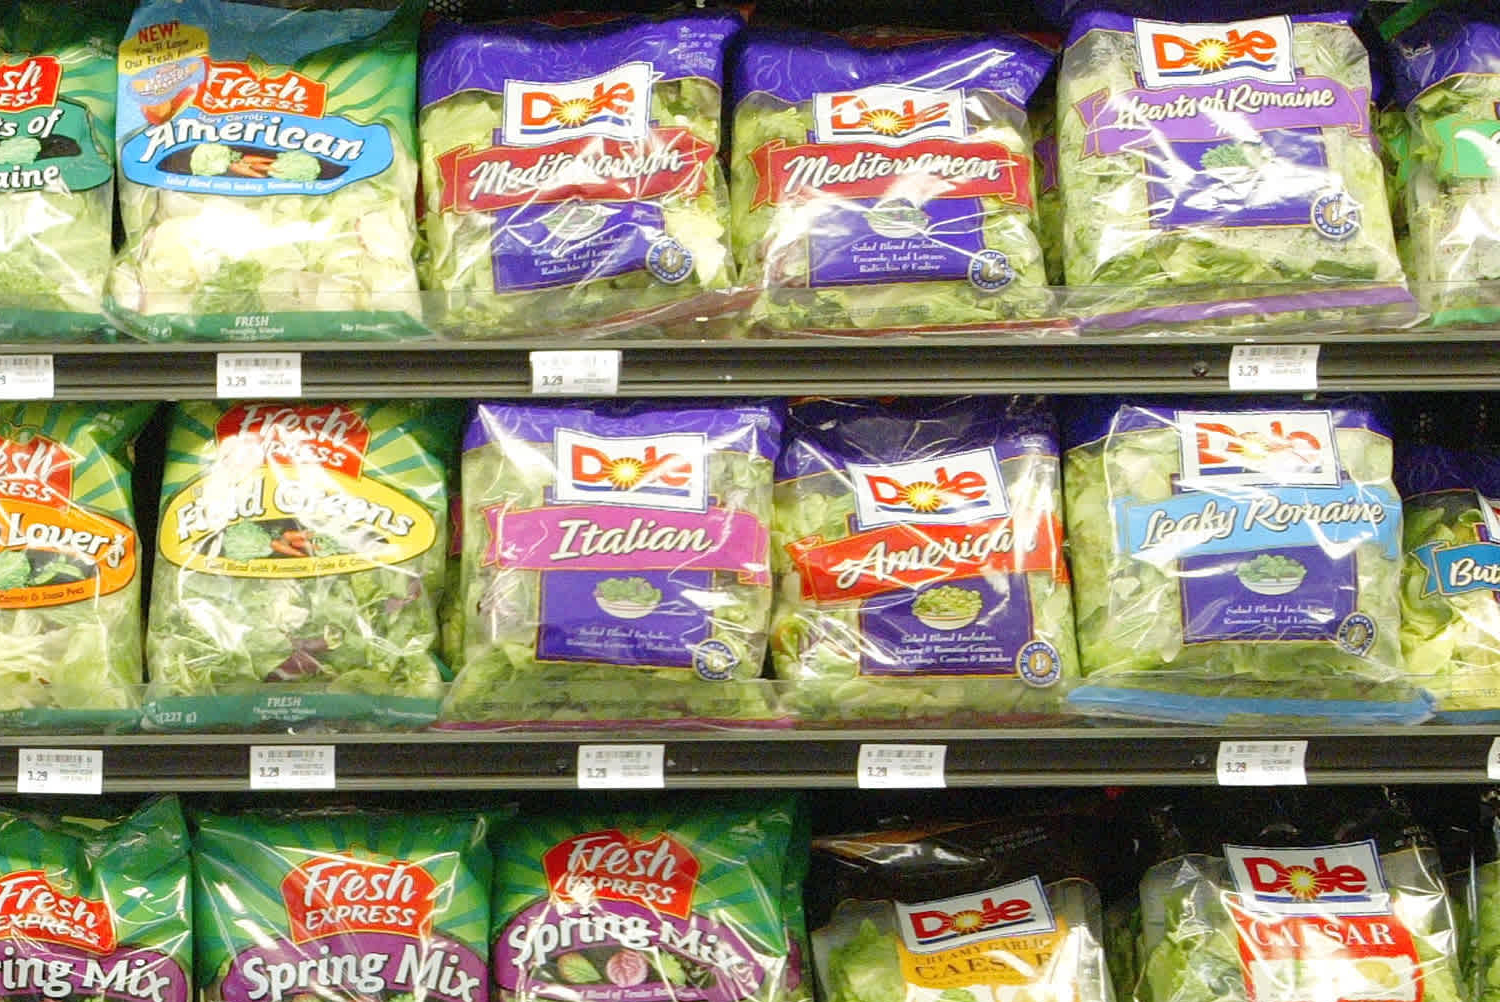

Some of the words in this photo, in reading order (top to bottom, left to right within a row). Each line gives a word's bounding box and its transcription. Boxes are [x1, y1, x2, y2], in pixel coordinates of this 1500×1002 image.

[137, 20, 181, 44] NEW!
[202, 92, 309, 113] EXPRESS
[206, 65, 308, 101] Fresh
[27, 110, 62, 137] of
[1117, 95, 1196, 128] Hearts
[1196, 90, 1226, 118] of
[1228, 85, 1334, 115] Romaine
[140, 114, 366, 162] American
[784, 148, 1001, 190] Mediterranean
[550, 516, 712, 560] Italian
[1141, 500, 1236, 550] Leafy
[1246, 497, 1386, 532] Romaine
[834, 523, 1037, 590] American
[565, 838, 678, 881] Fresh
[304, 860, 418, 905] Fresh
[305, 905, 416, 930] EXPRESS
[243, 946, 388, 1000] Spring
